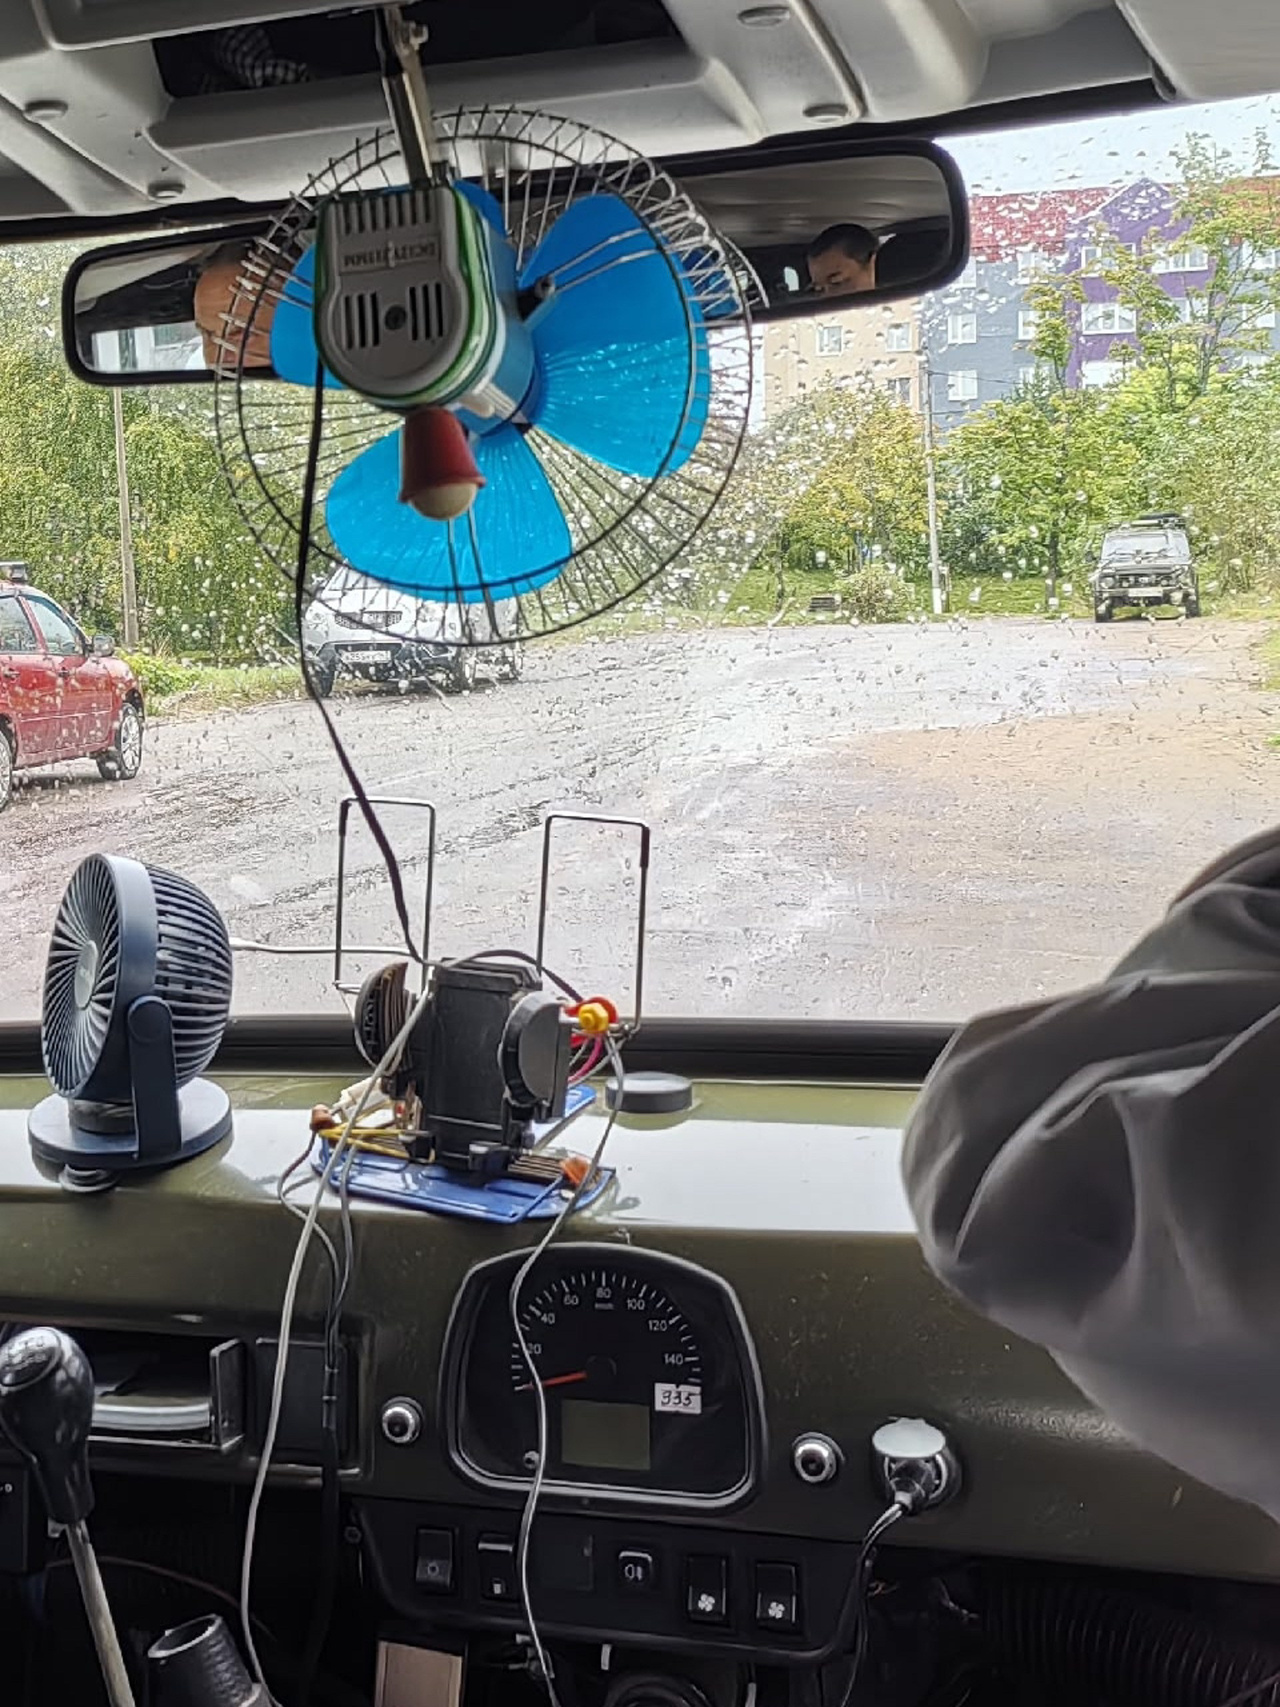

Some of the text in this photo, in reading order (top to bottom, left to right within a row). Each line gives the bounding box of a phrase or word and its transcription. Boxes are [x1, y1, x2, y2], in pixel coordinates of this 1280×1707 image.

[595, 1287, 612, 1298] 80
[563, 1294, 579, 1305] 60
[626, 1299, 645, 1310] 100
[540, 1312, 556, 1324] 40
[648, 1319, 668, 1331] 120
[663, 1353, 684, 1365] 140
